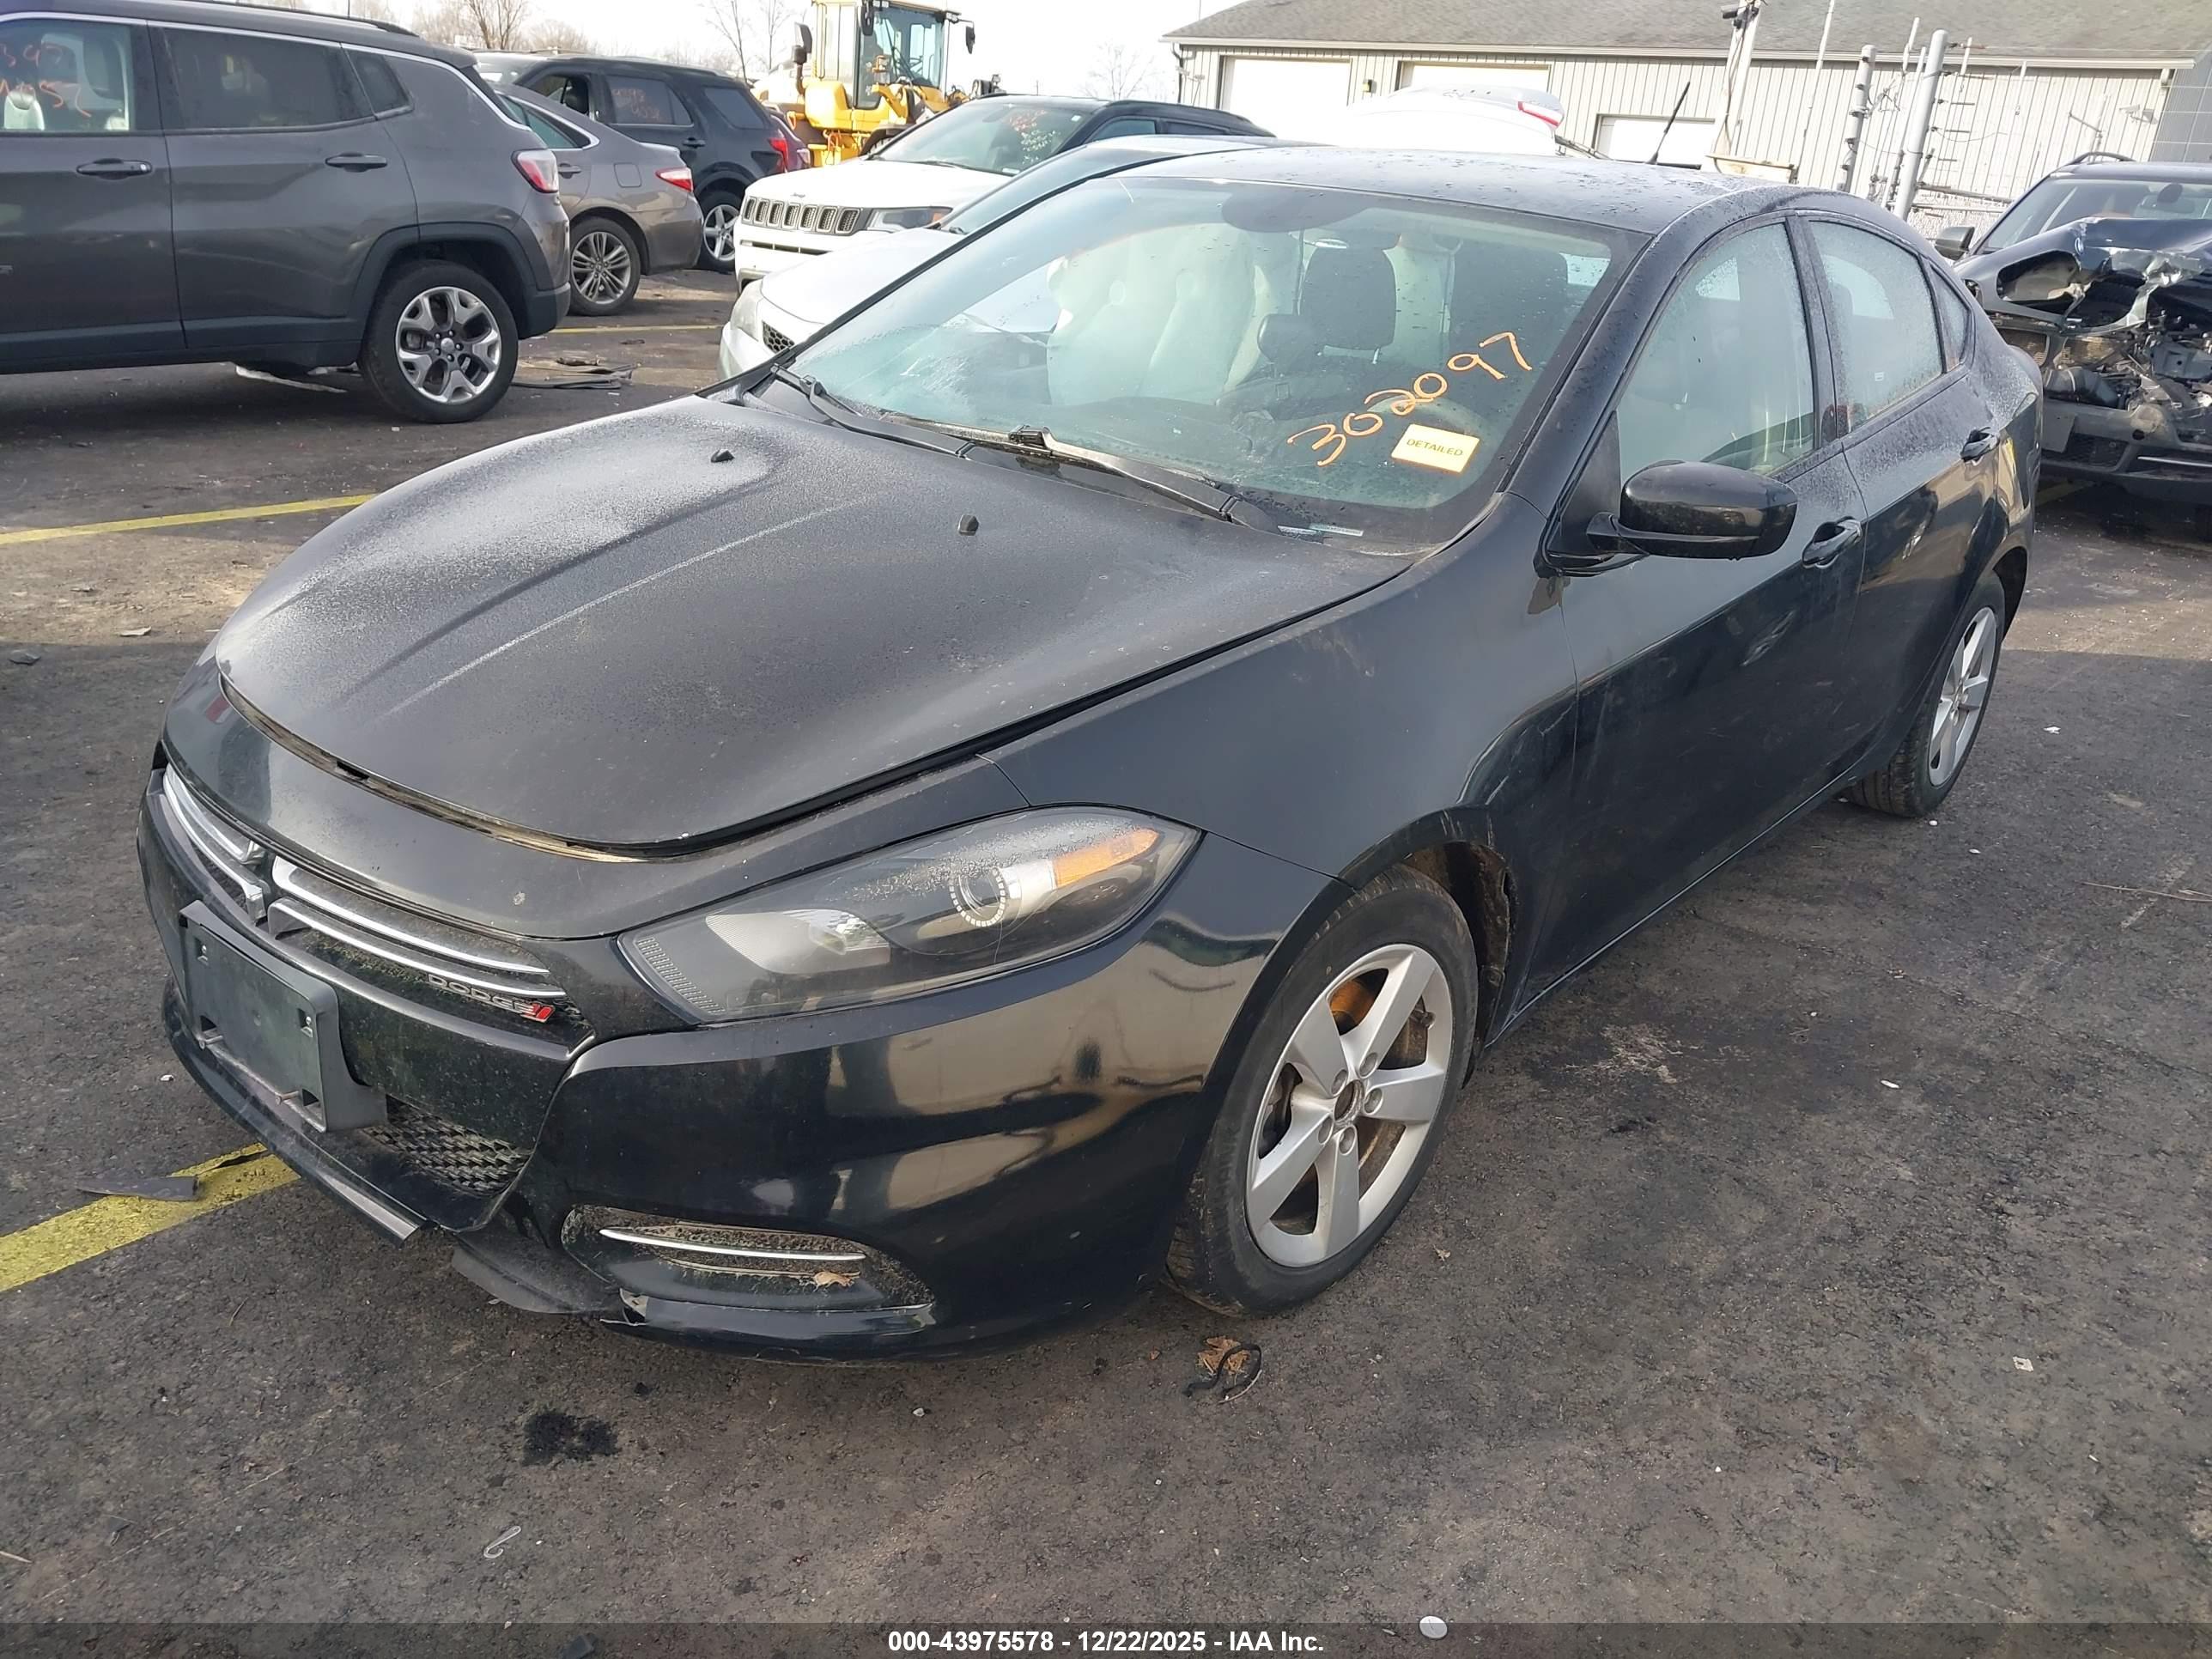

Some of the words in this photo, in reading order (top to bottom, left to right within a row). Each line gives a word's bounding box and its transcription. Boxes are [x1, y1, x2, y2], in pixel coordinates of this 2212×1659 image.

[1286, 331, 1534, 467] 302097
[1406, 438, 1464, 457] DETAILED
[426, 973, 534, 1016] DODGE
